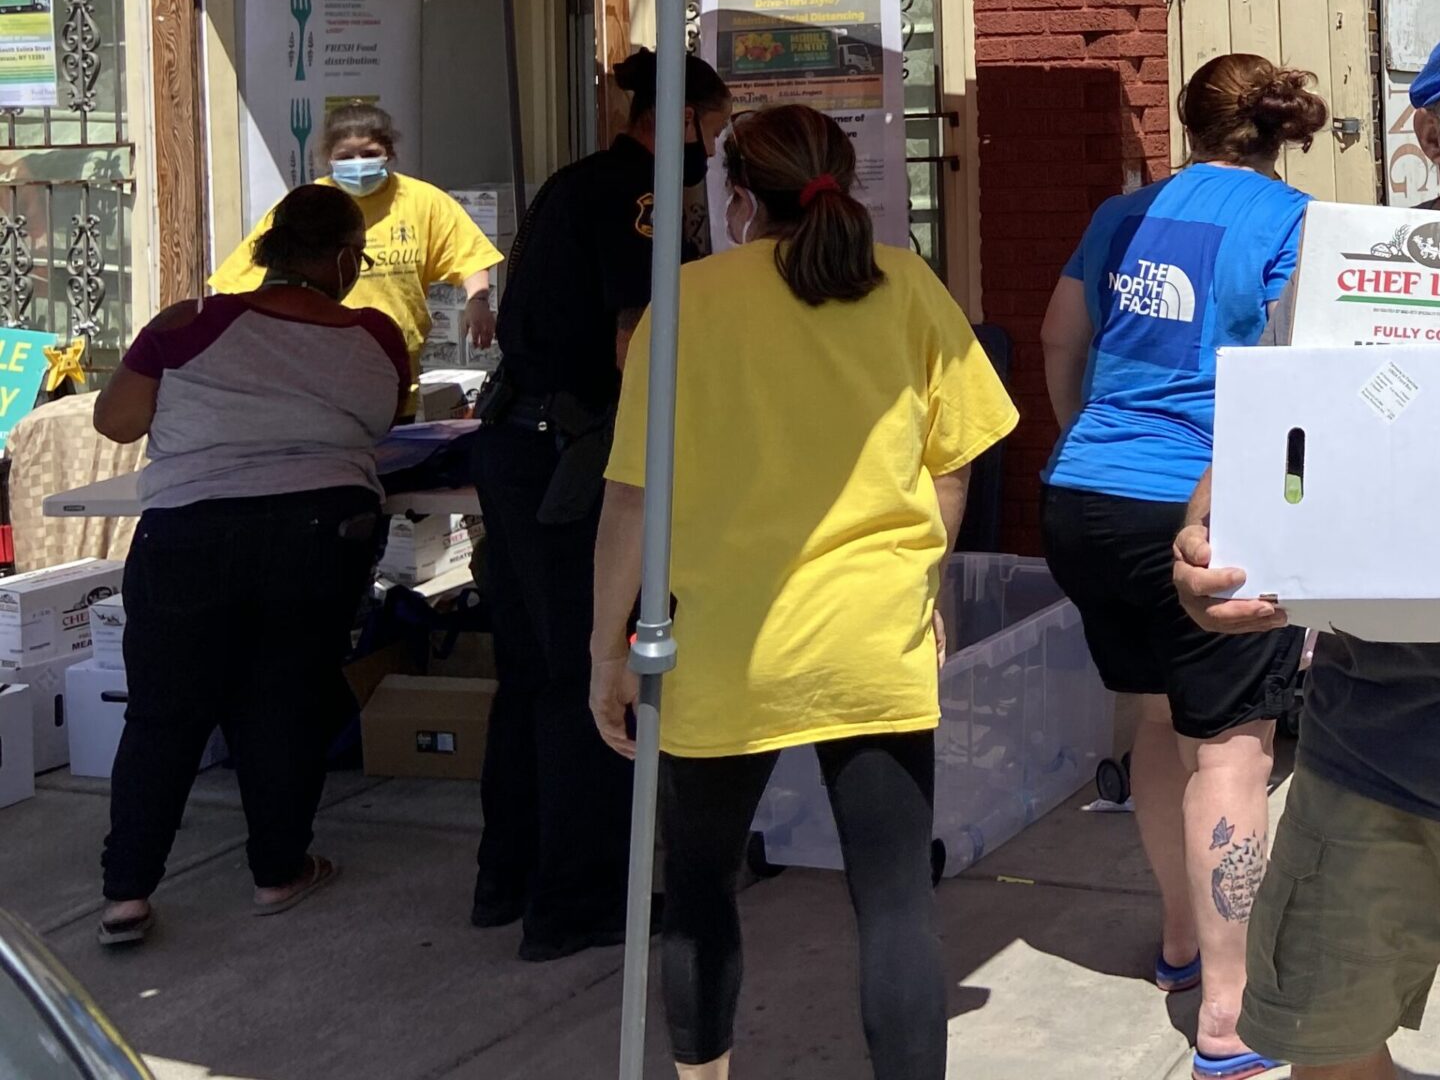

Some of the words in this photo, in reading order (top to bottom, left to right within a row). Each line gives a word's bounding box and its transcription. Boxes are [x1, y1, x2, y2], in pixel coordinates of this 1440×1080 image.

[832, 114, 854, 123] rner
[1138, 259, 1169, 281] THE
[1108, 272, 1164, 300] NORTH
[1336, 269, 1422, 295] CHEF
[1119, 294, 1161, 318] FACE
[1373, 325, 1421, 339] FULLY
